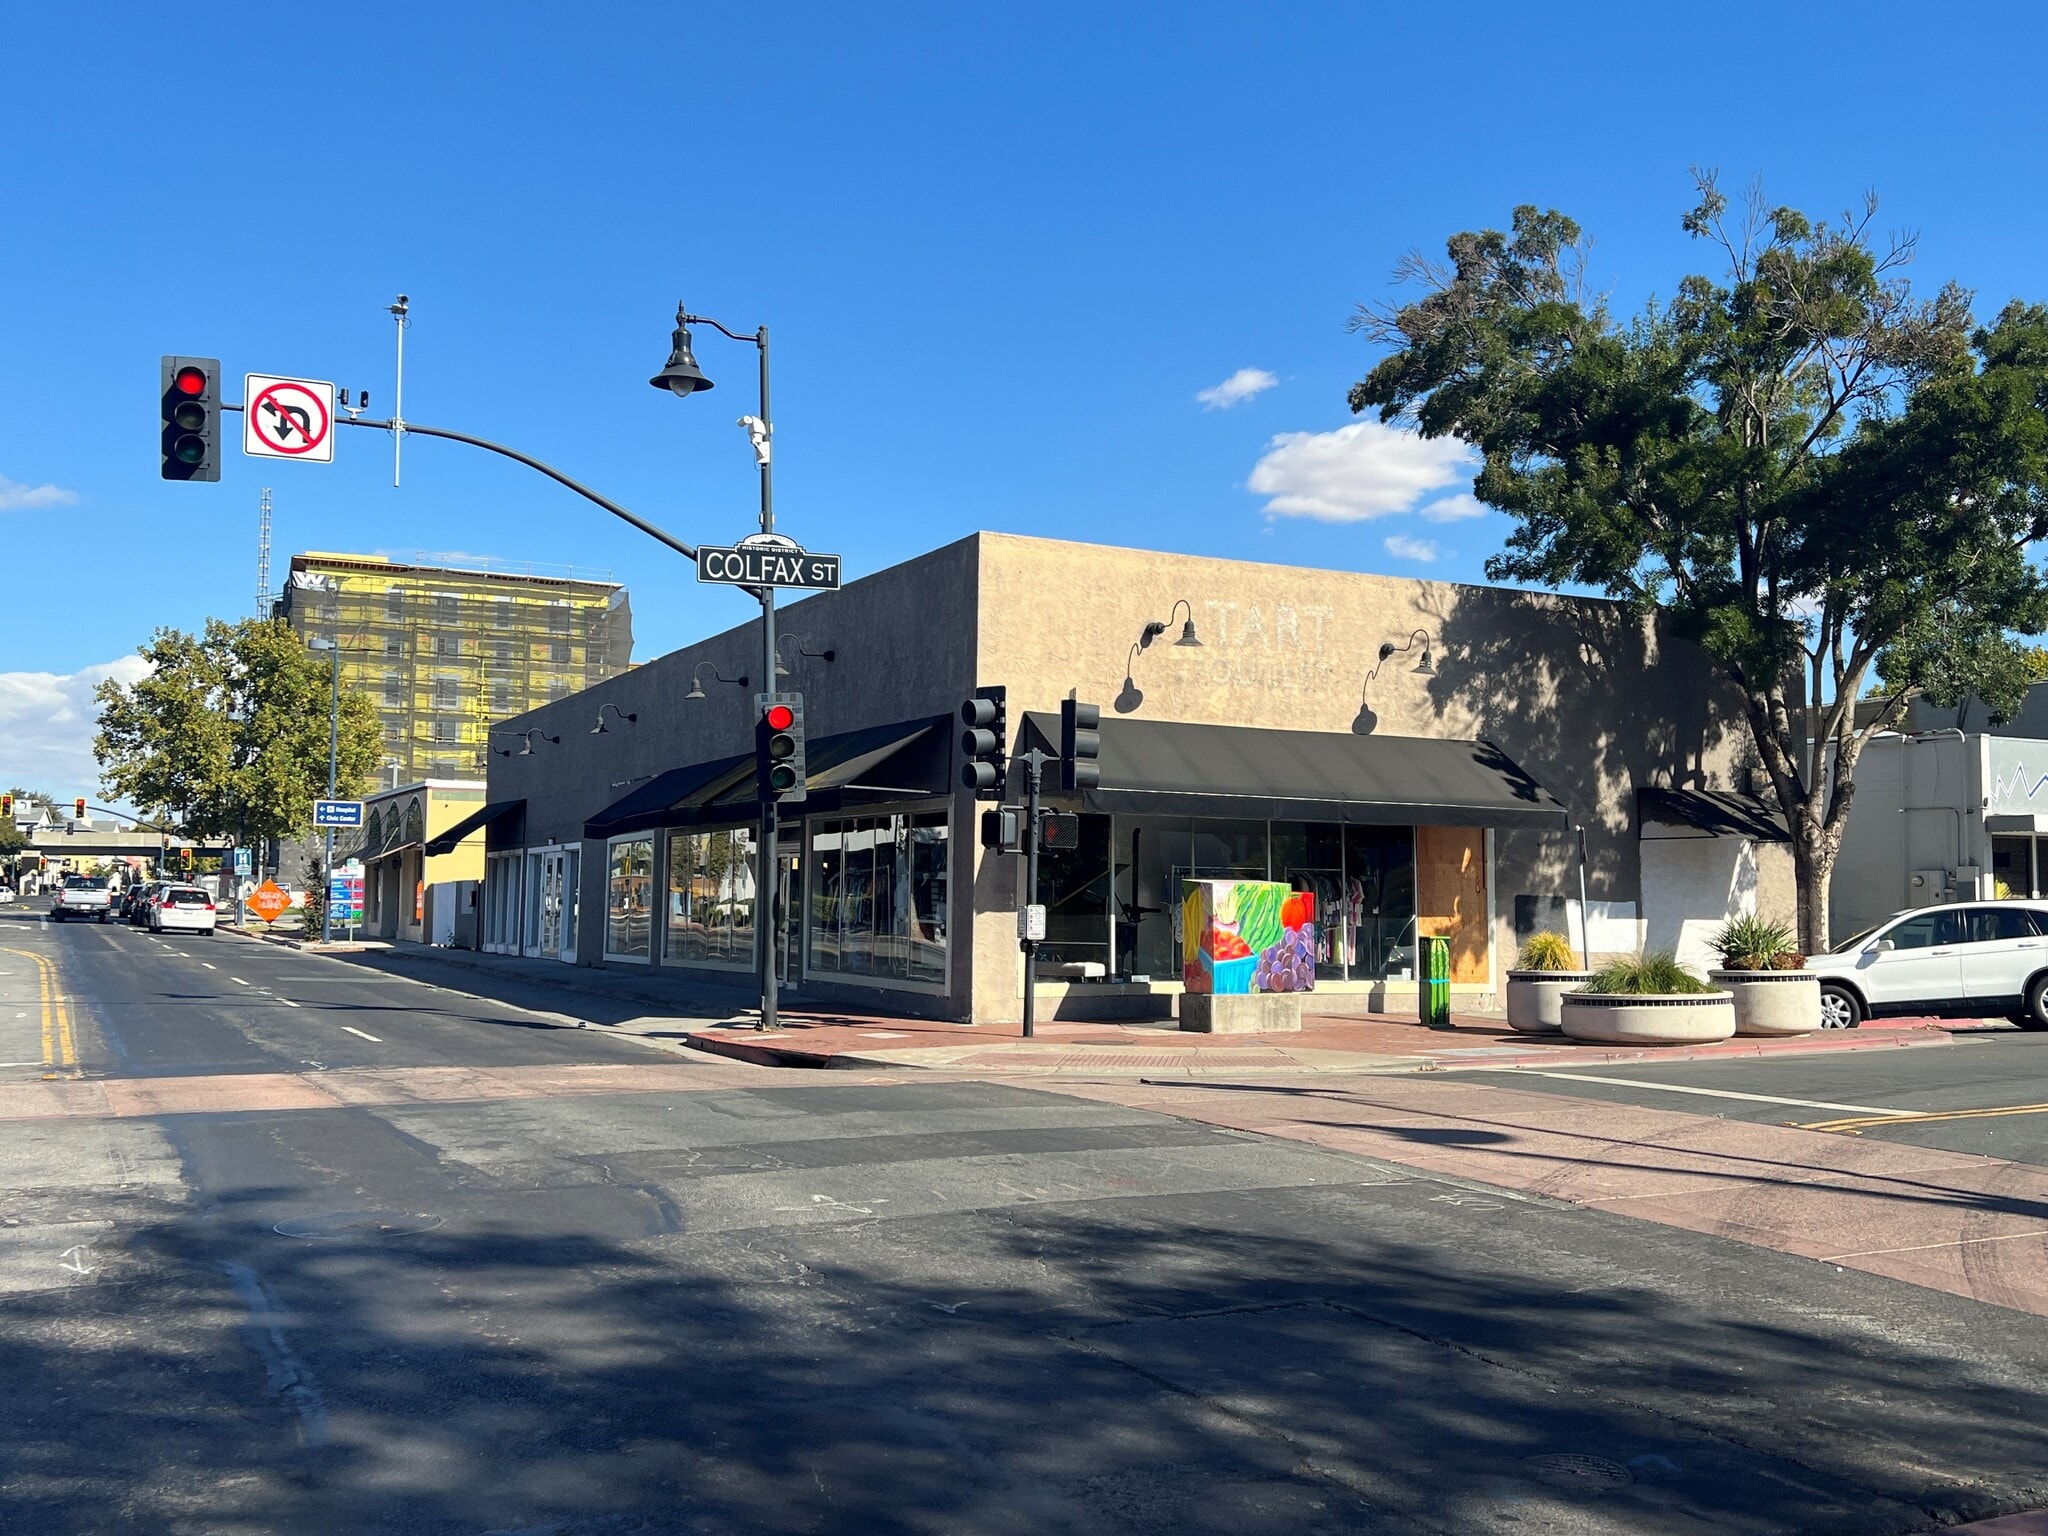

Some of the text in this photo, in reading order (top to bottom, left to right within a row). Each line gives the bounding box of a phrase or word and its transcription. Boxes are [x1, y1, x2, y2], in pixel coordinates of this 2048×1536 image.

[706, 552, 836, 583] COLFAX ST
[1205, 600, 1334, 652] TART
[239, 853, 247, 864] H
